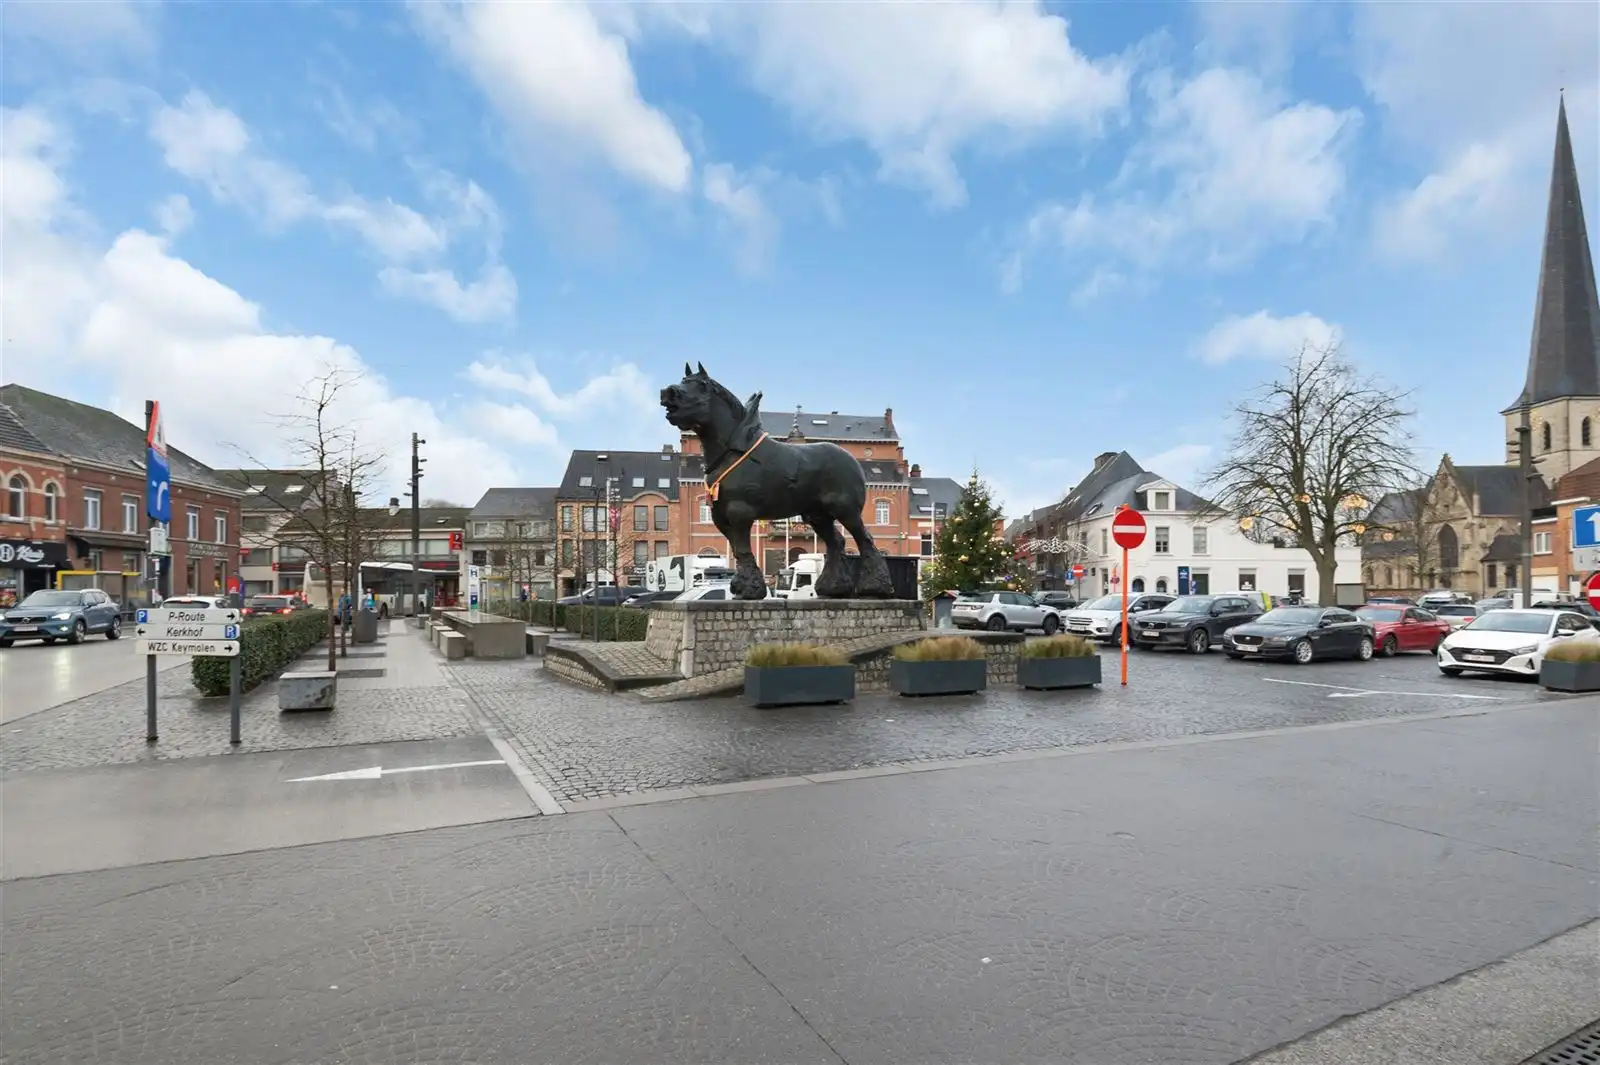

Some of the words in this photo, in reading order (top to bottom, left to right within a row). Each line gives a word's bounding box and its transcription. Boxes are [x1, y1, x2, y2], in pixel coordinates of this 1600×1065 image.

[168, 611, 206, 621] P-Route
[166, 626, 204, 637] Kerkhof
[148, 642, 168, 652] WZC
[172, 643, 216, 655] Keymolen
